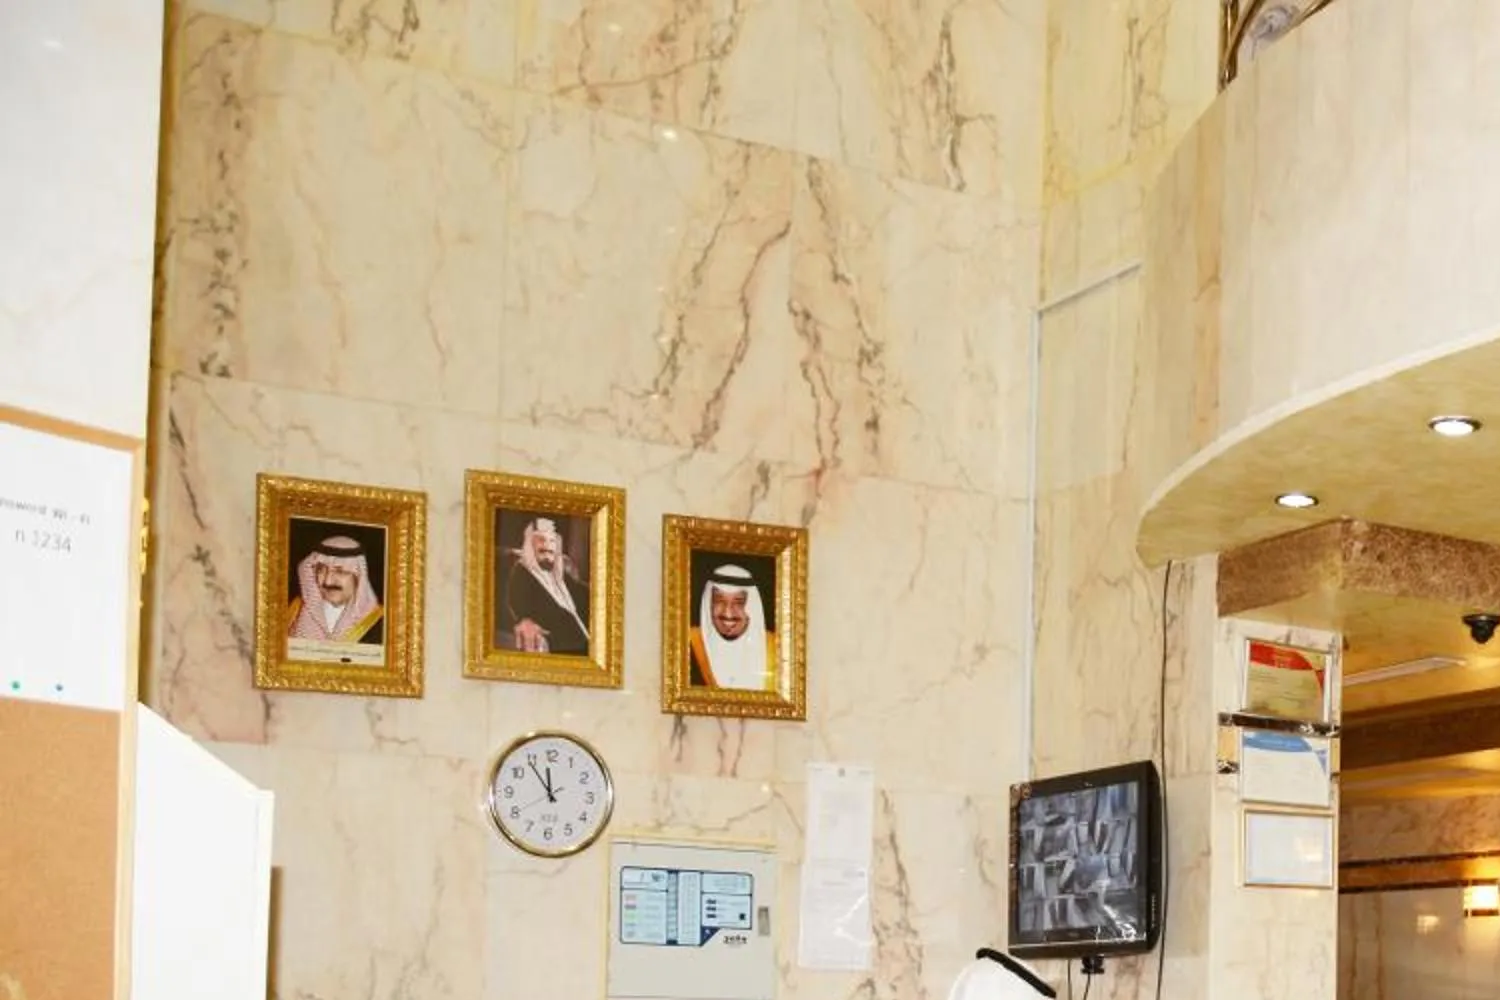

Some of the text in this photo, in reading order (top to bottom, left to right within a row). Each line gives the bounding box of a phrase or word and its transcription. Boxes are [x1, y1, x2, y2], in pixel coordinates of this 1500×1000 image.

[32, 529, 72, 553] 1234
[546, 749, 559, 762] 12
[568, 756, 574, 769] 1
[512, 766, 525, 779] 10
[580, 771, 590, 784] 2
[503, 785, 514, 799] 9
[586, 791, 595, 805] 3
[510, 805, 521, 819] 8
[578, 811, 588, 824] 4
[525, 820, 535, 832] 7
[563, 823, 574, 837] 5
[544, 827, 553, 840] 6
